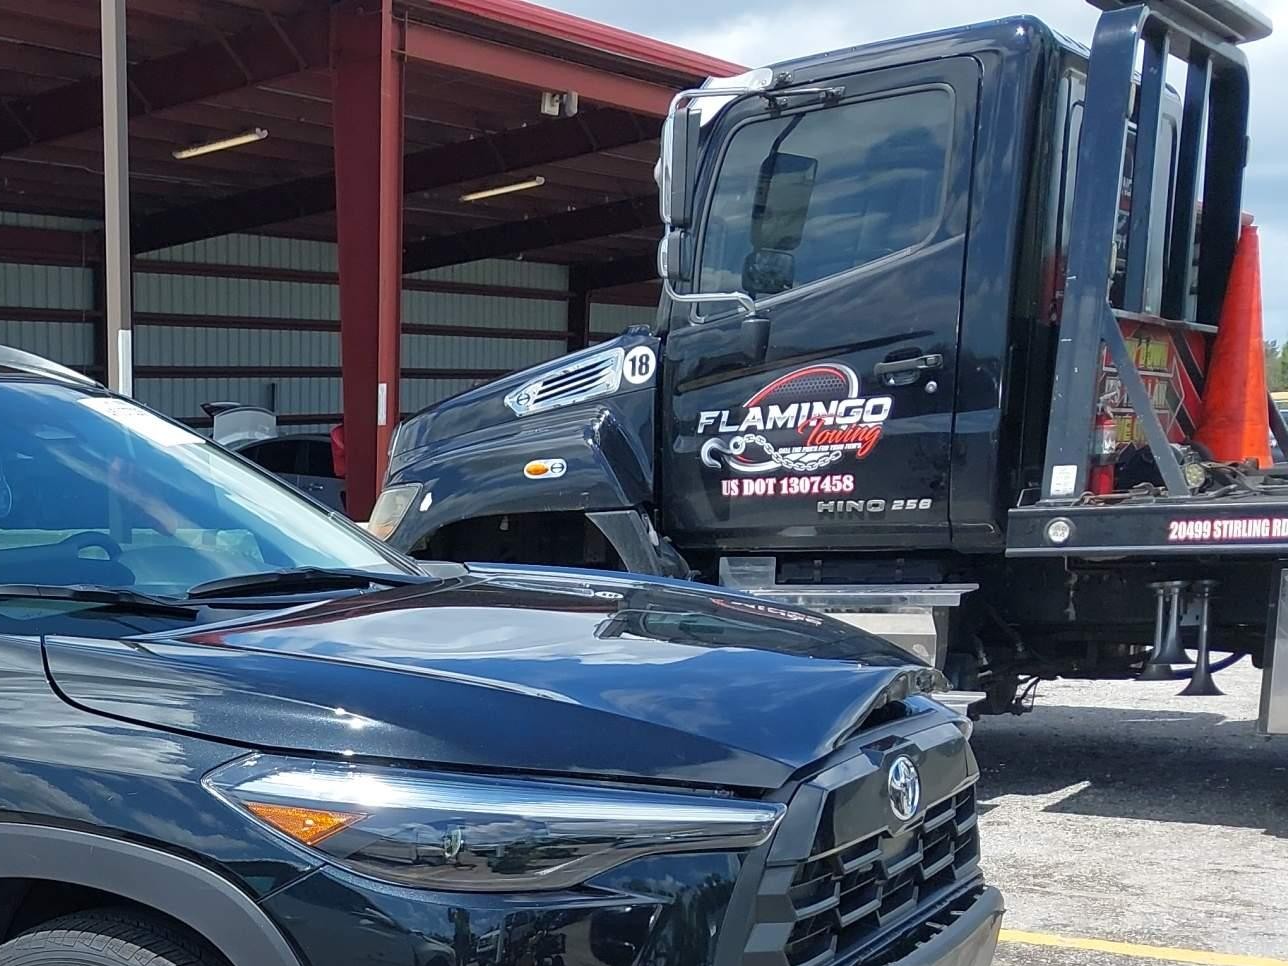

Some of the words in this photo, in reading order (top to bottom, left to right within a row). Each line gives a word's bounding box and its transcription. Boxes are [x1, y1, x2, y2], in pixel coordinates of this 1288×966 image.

[629, 354, 650, 377] 18
[696, 397, 894, 434] FLAMINGO
[798, 416, 882, 459] Towing
[721, 478, 740, 497] US
[743, 477, 777, 496] DOT
[780, 475, 855, 494] 1307458
[817, 500, 886, 513] HINO
[891, 498, 933, 511] 258
[1169, 520, 1211, 540] 20499
[1213, 518, 1272, 539] STIRLING
